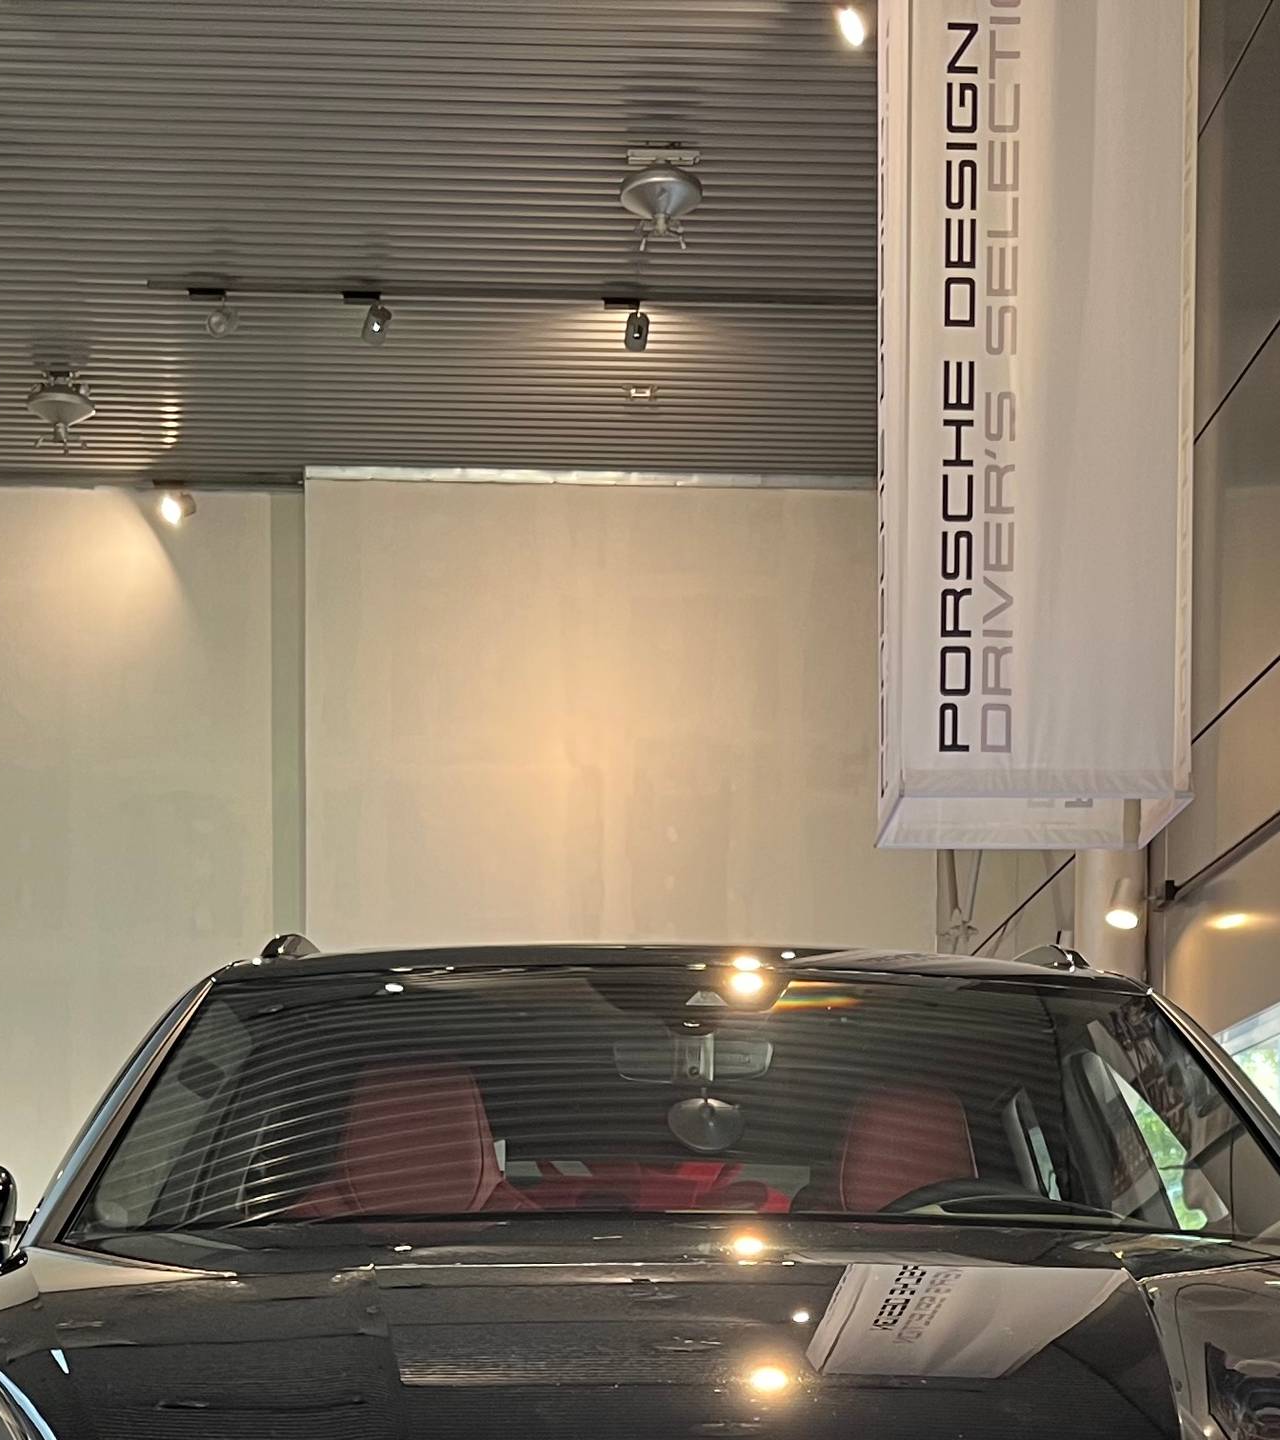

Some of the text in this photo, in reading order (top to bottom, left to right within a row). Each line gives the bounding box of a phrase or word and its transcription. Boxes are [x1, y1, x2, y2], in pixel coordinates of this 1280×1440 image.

[939, 22, 979, 752] PORSCHE DESIGN
[981, 0, 1021, 753] DRIVER'S SELECTI
